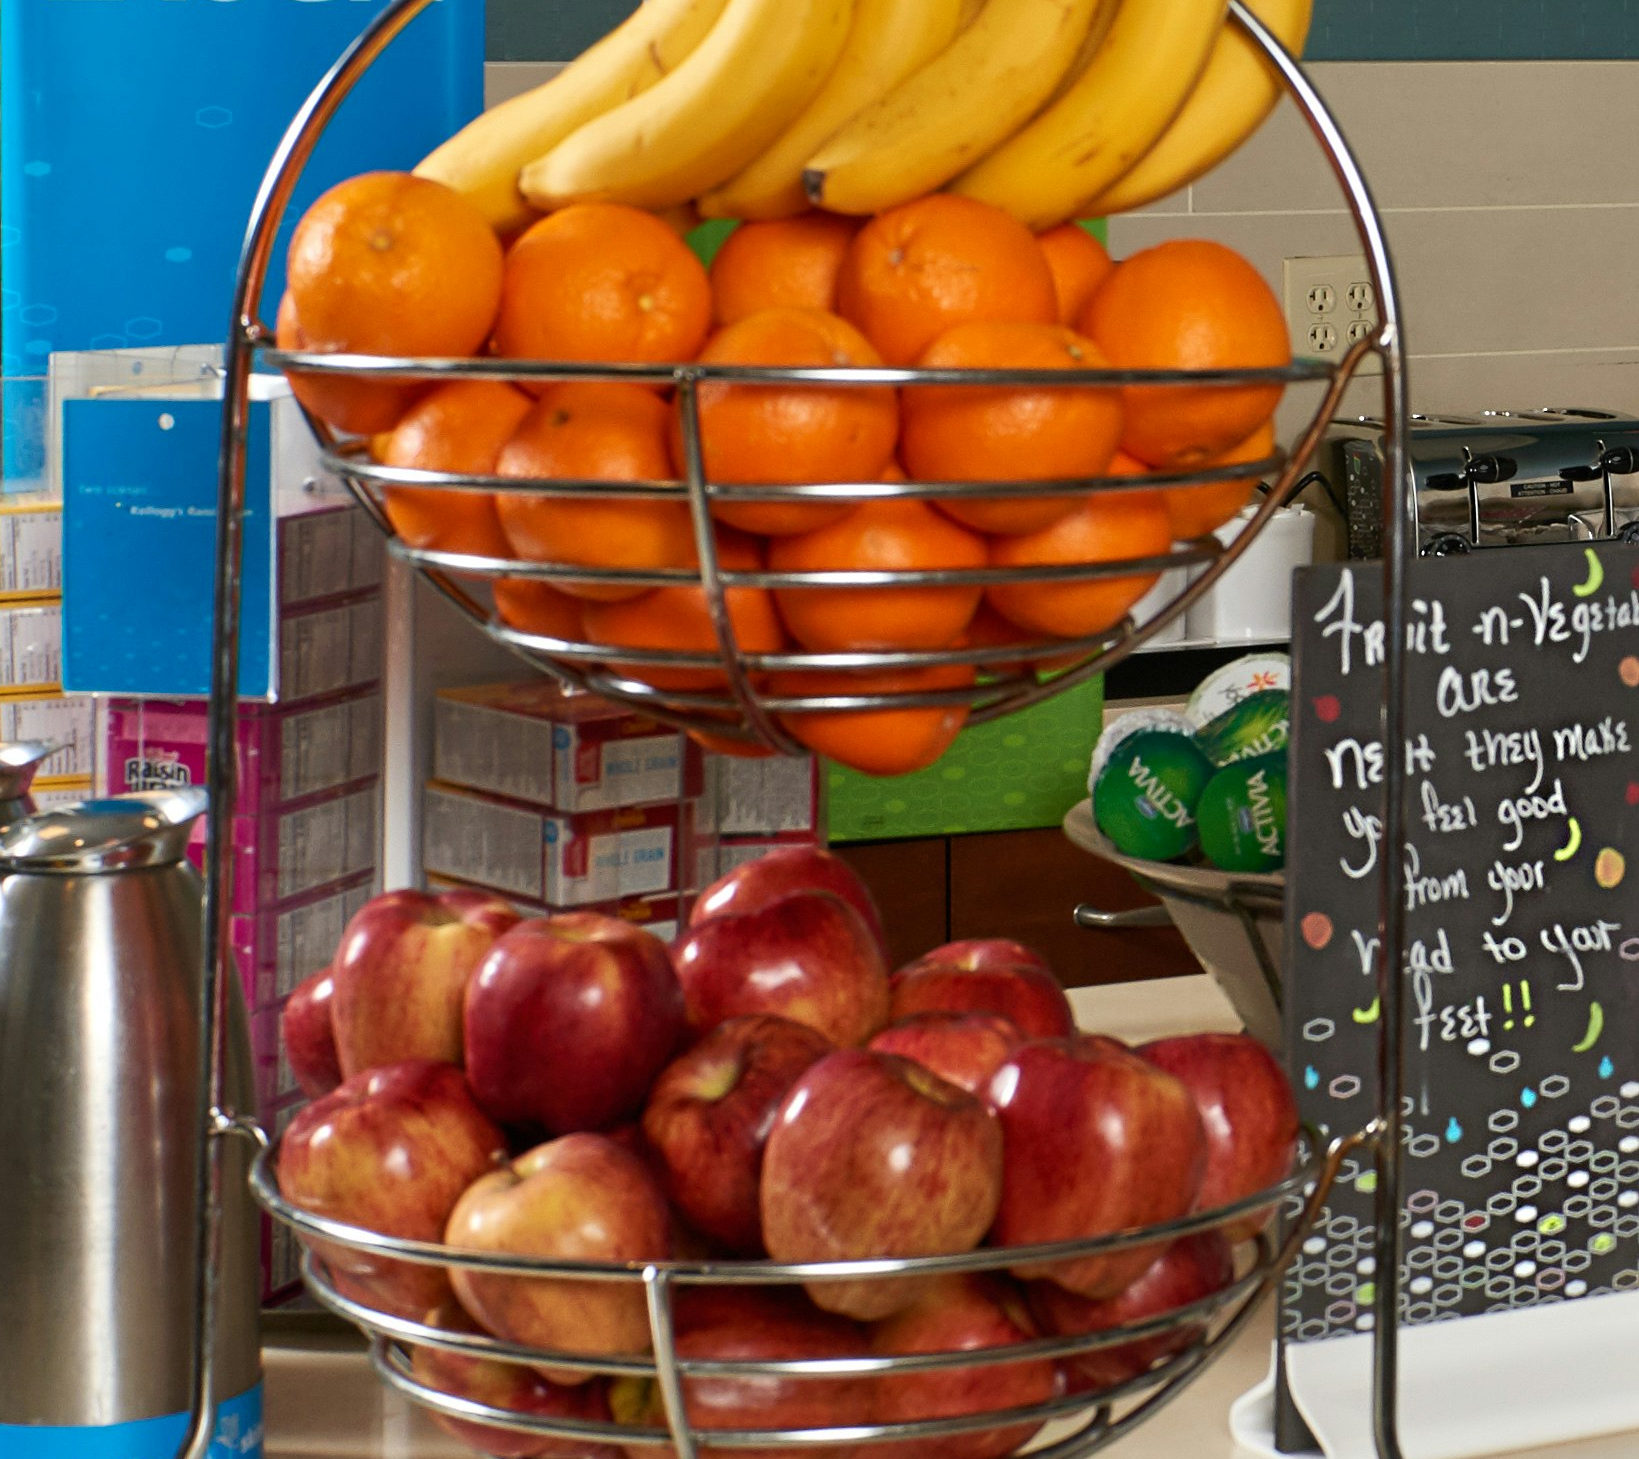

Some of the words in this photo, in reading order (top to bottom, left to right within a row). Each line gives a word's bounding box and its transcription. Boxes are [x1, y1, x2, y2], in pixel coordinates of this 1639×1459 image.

[1128, 754, 1195, 829] ACTIVIA
[1464, 729, 1543, 794] they
[1246, 768, 1281, 856] ACTIVIA
[1497, 779, 1568, 851] good
[1482, 932, 1527, 963] to
